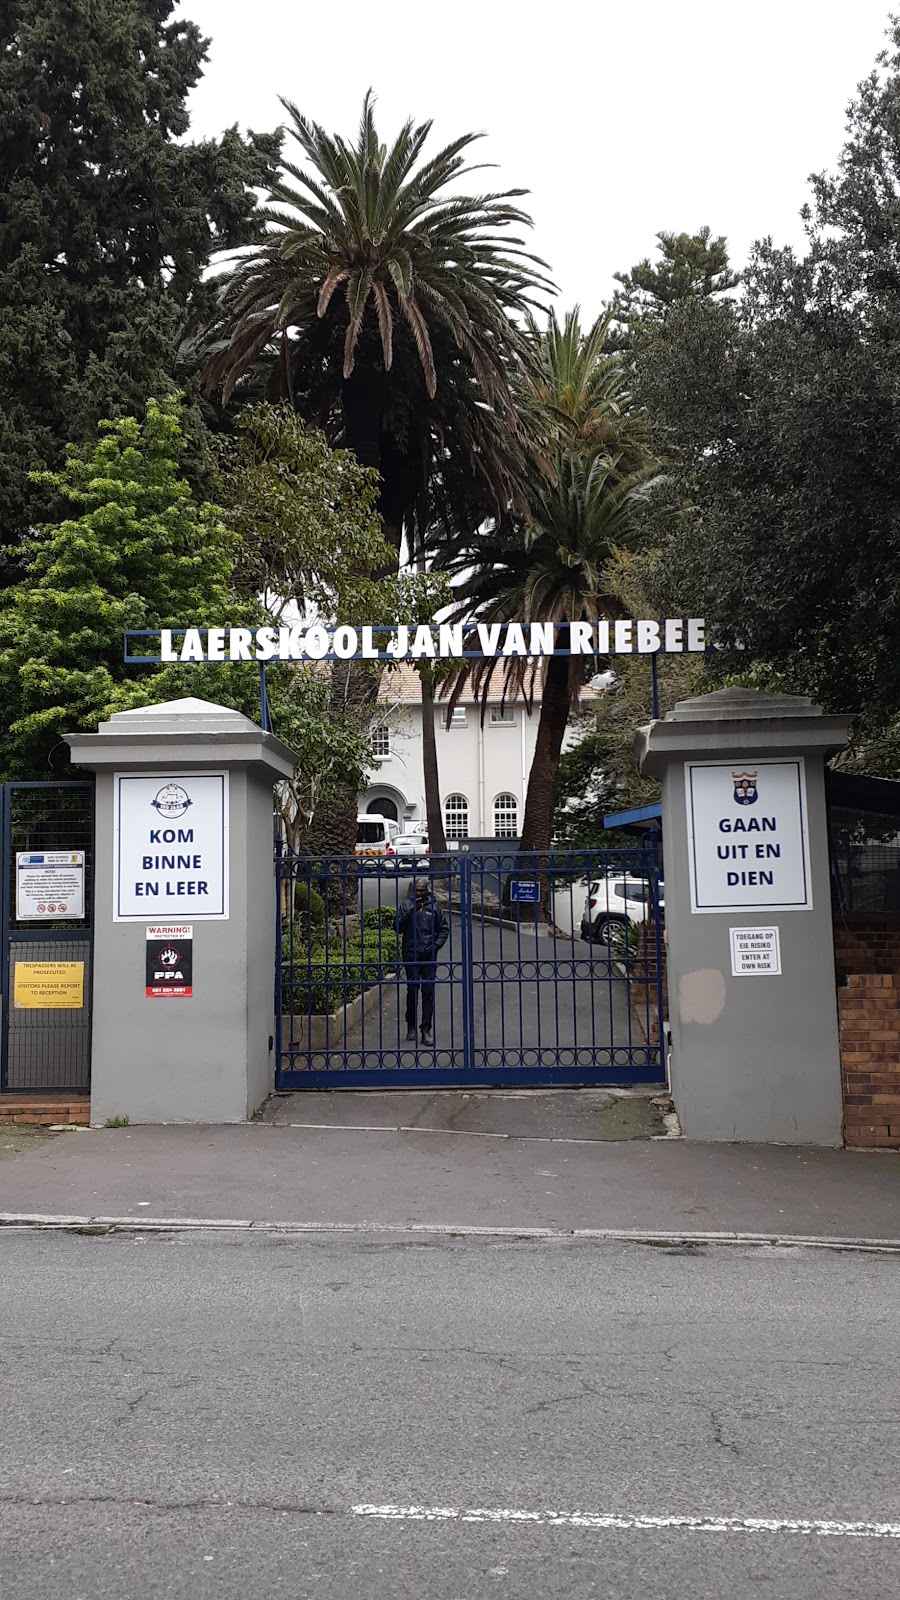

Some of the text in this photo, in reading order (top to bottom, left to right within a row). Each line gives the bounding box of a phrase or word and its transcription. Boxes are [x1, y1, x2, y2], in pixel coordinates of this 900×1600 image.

[160, 618, 745, 661] LAERSKOOL JAN VAN RIEBEE
[719, 817, 777, 833] GAAN
[150, 829, 194, 843] KOM
[717, 844, 781, 860] UIT EN
[143, 855, 202, 870] BINNE
[727, 871, 774, 886] DIEN
[135, 881, 209, 896] EN LEER
[154, 971, 184, 979] PPA
